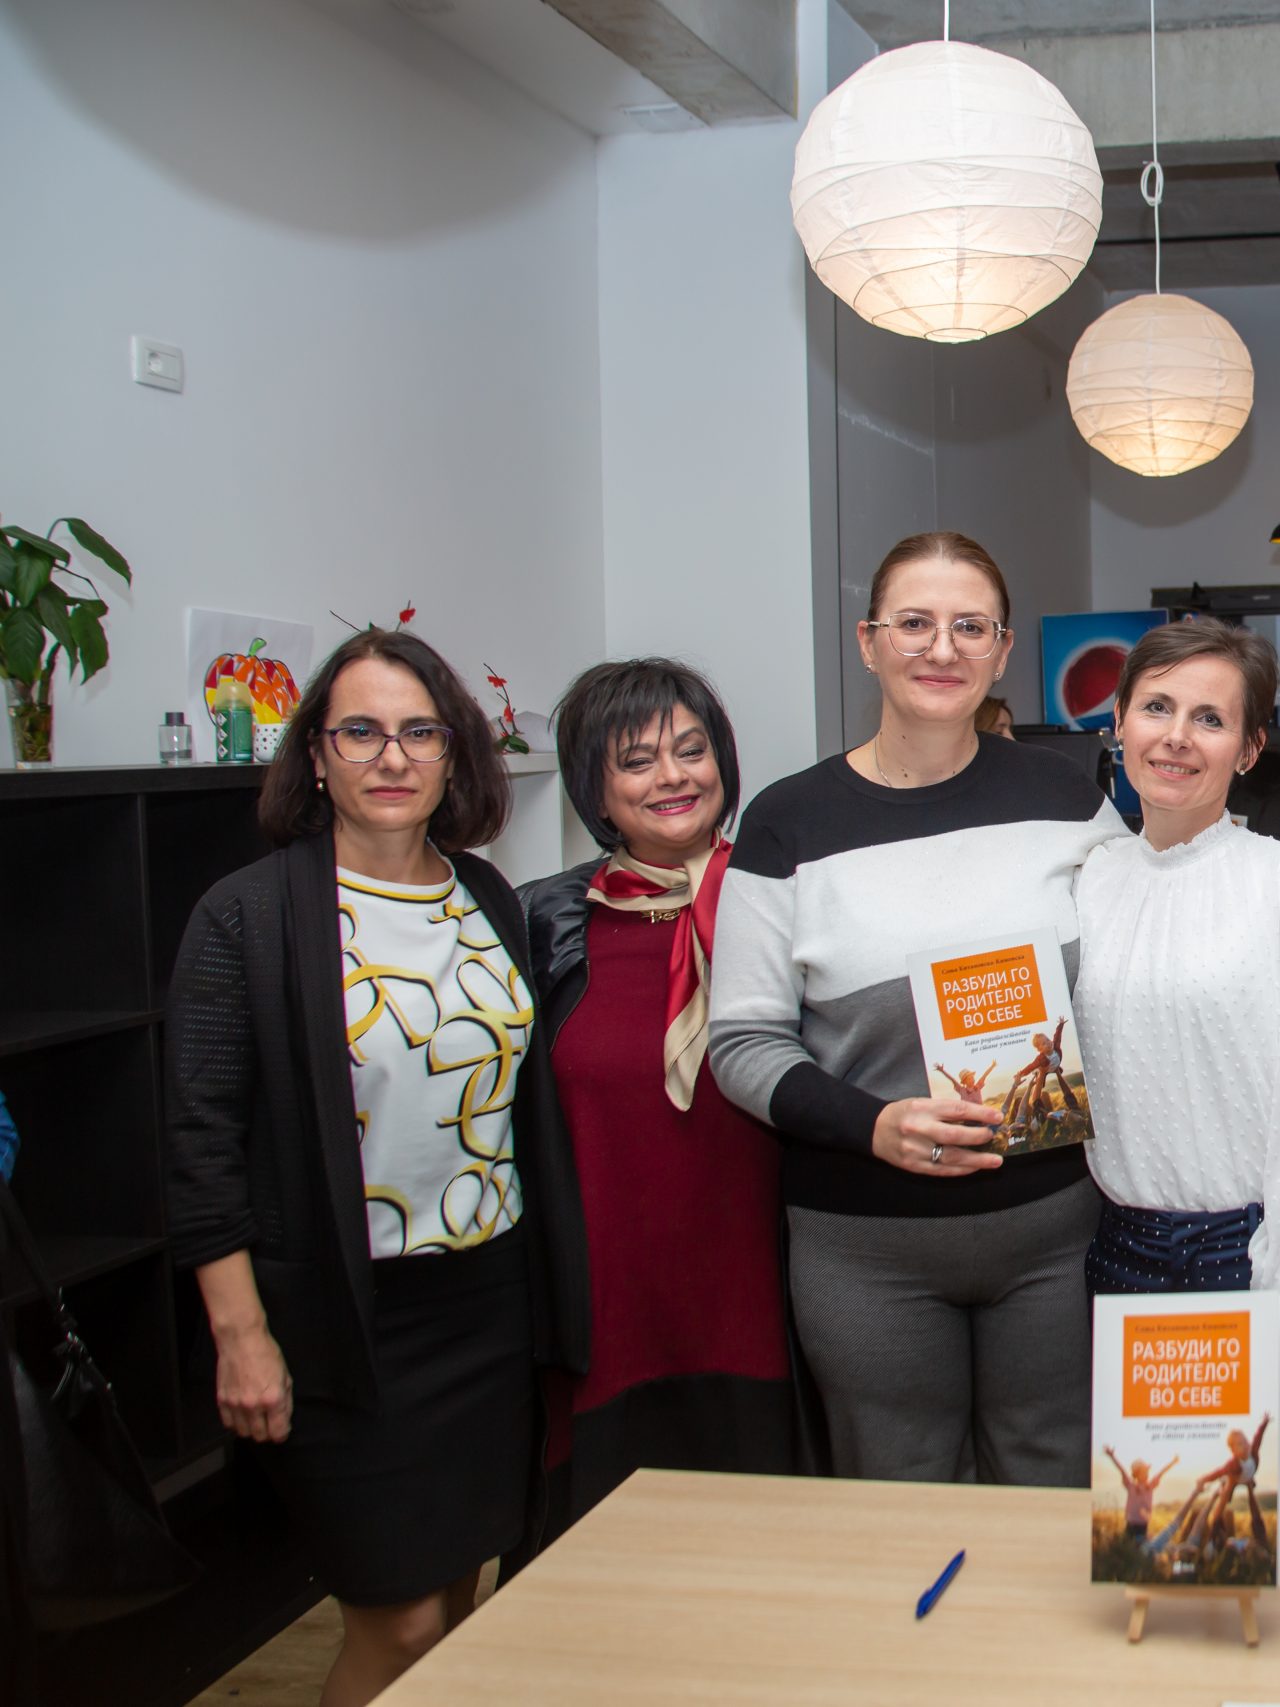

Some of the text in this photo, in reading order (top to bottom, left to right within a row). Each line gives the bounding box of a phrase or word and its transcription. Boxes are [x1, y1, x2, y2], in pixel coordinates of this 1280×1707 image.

[942, 966, 1030, 996] РАЗБУДИ ГО
[946, 984, 1034, 1014] РОДИТЕЛОТ
[963, 1004, 1023, 1029] ВО СЕБЕ
[1132, 1337, 1241, 1361] РАЗБУДИ ГО
[1132, 1361, 1240, 1385] РОДИТЕЛОТ
[1149, 1385, 1223, 1408] ВО СЕБЕ
